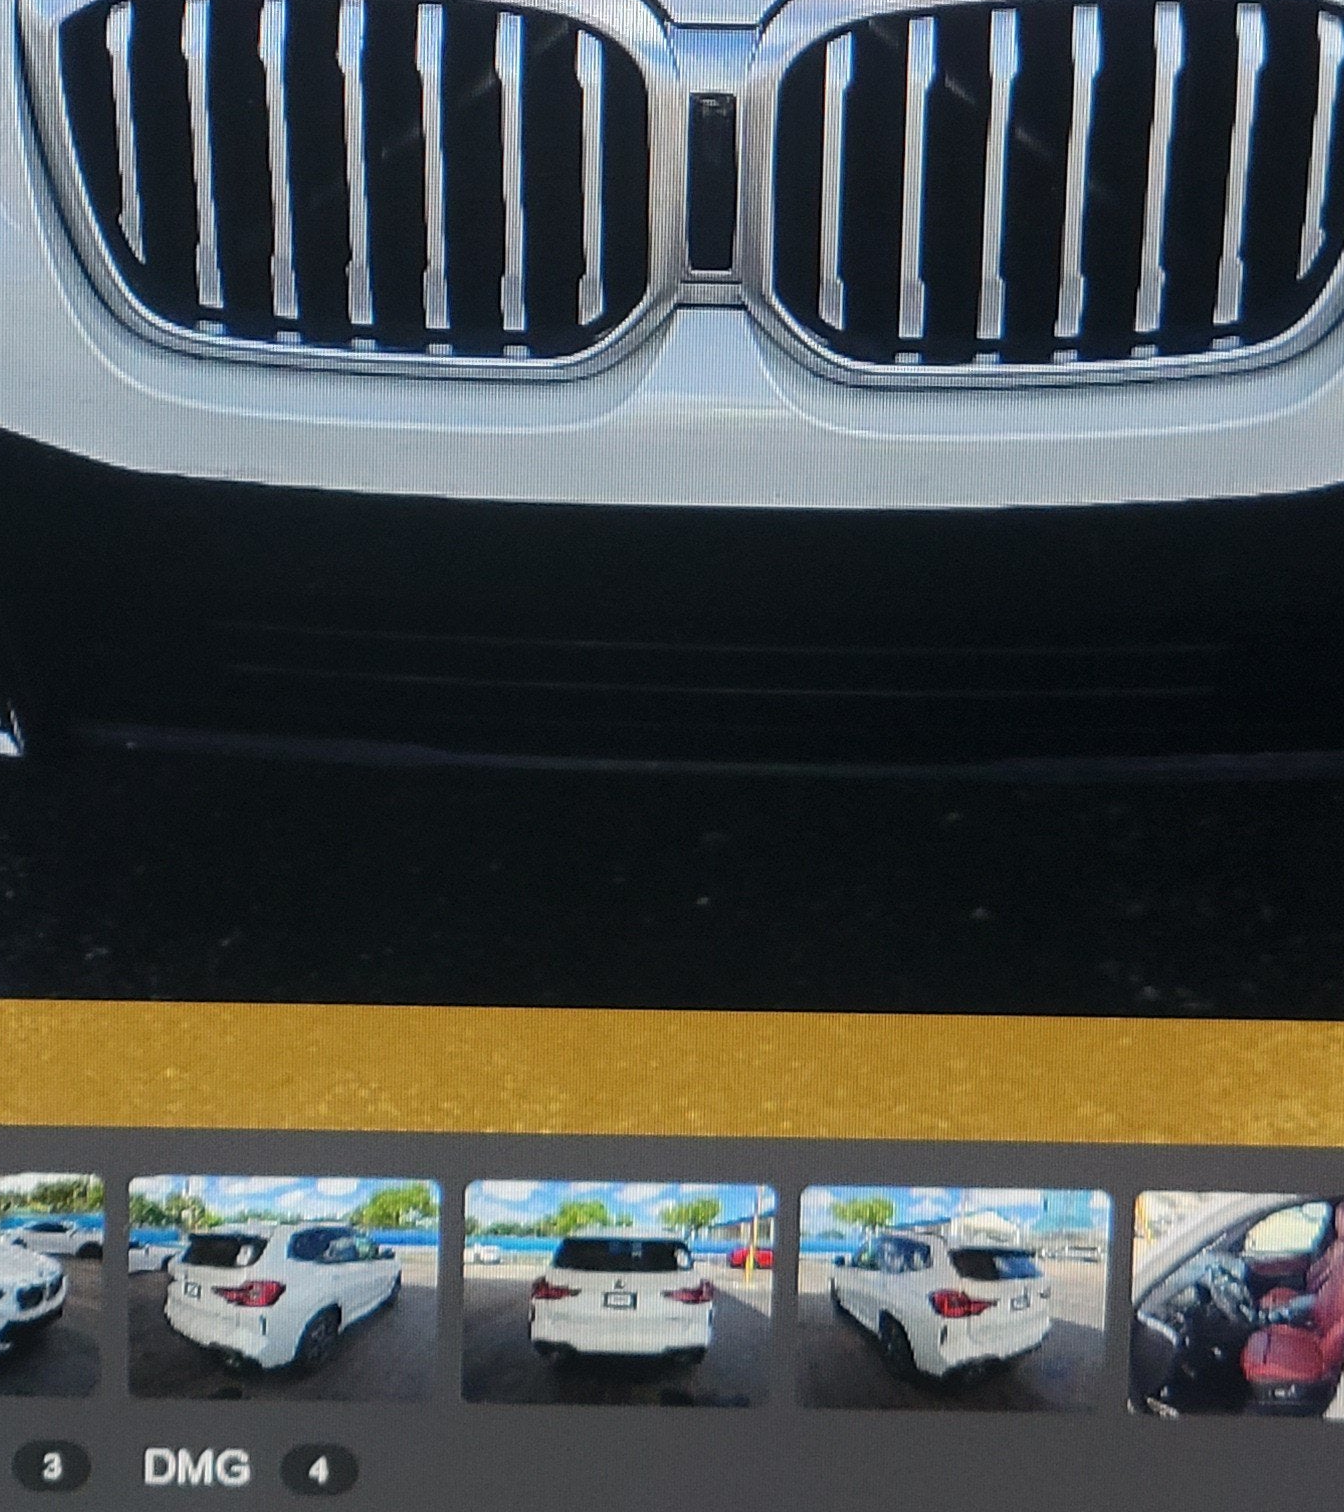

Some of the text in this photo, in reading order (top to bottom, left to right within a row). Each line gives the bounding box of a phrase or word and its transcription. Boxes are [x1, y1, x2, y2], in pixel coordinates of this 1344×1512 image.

[43, 1452, 63, 1481] 3
[144, 1447, 329, 1486] DMG 4
